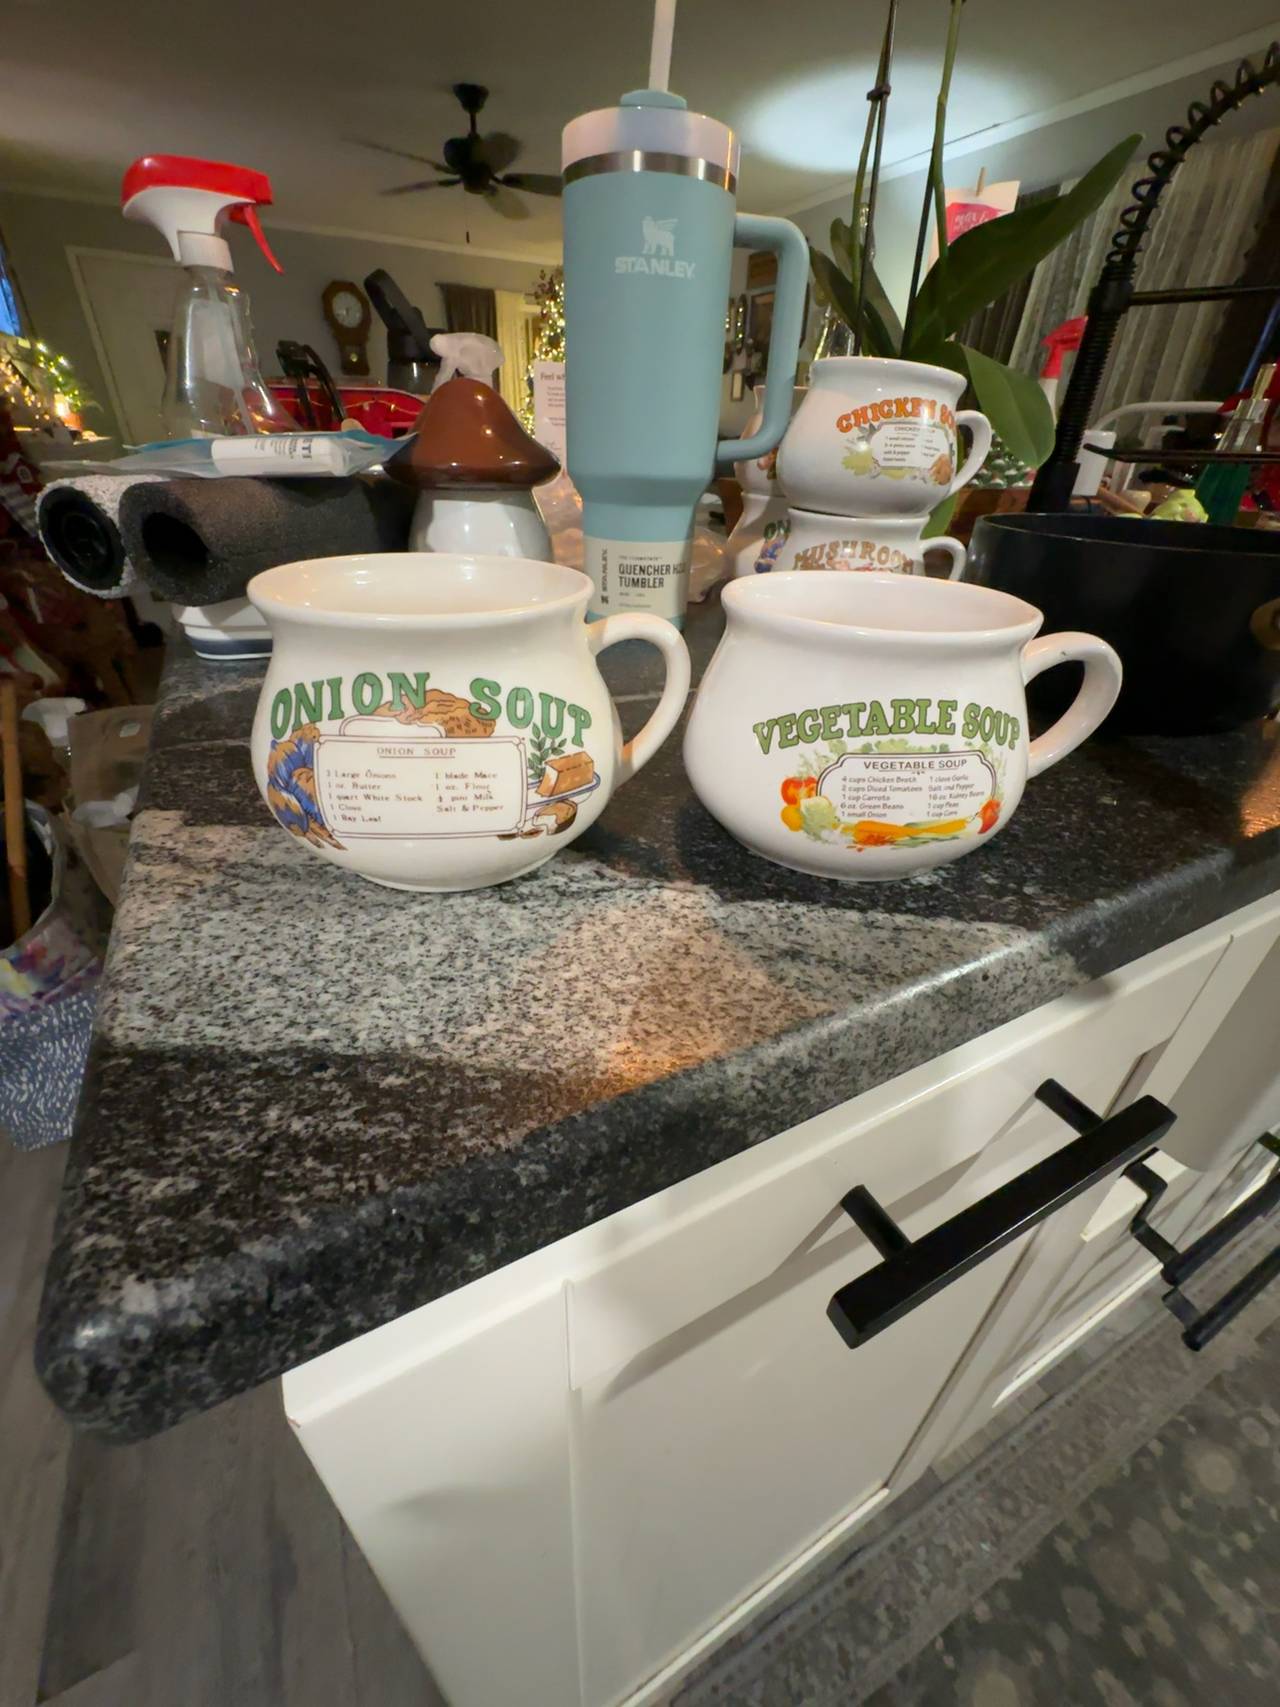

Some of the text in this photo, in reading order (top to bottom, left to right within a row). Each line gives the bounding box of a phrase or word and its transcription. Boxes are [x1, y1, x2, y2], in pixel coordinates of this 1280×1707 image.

[614, 256, 696, 280] STANLEY
[618, 563, 671, 576] QUENCHER
[618, 576, 664, 589] TUMBLER
[270, 671, 593, 748] ONION SOUP
[752, 698, 1020, 754] VEGETABLE SOUP
[376, 747, 456, 755] ONION SOUP
[863, 759, 967, 770] VEGETABLE SOUP
[352, 782, 381, 790] Butter
[363, 793, 390, 801] White
[395, 793, 423, 801] Stock
[473, 791, 493, 801] Milk
[862, 793, 890, 801] Carrots
[472, 804, 504, 812] Pepper
[341, 814, 357, 822] Bay
